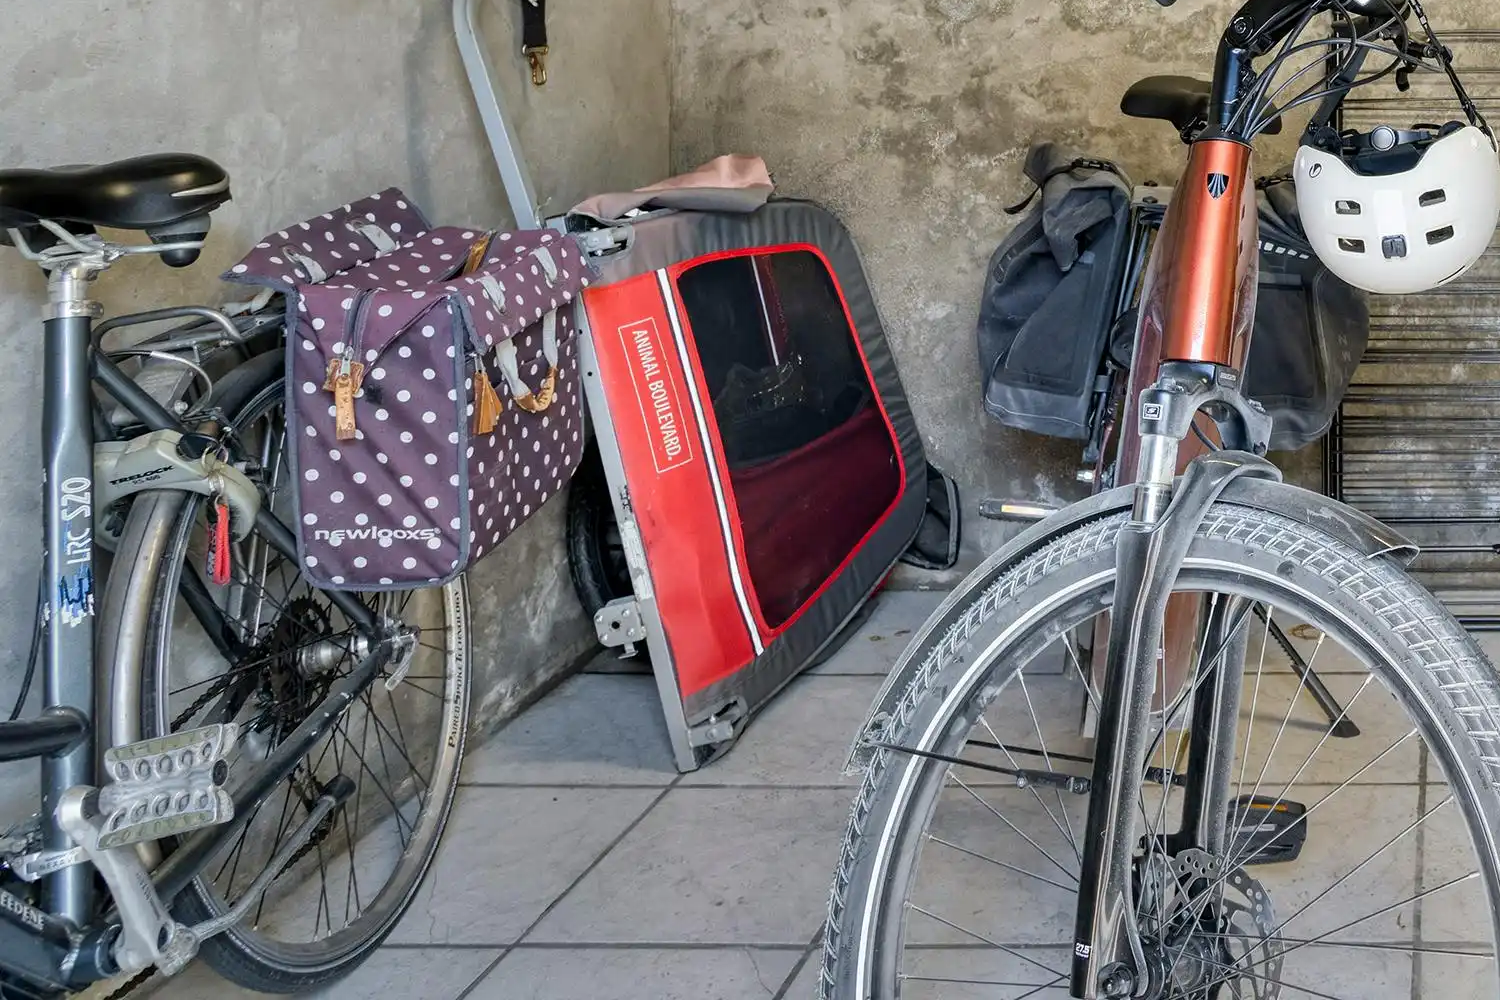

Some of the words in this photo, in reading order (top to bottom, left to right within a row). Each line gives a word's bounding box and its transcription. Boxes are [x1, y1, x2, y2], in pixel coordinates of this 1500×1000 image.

[632, 329, 660, 381] ANIMAL
[648, 380, 681, 461] BOULEVARD.
[109, 464, 177, 486] TRELOCK
